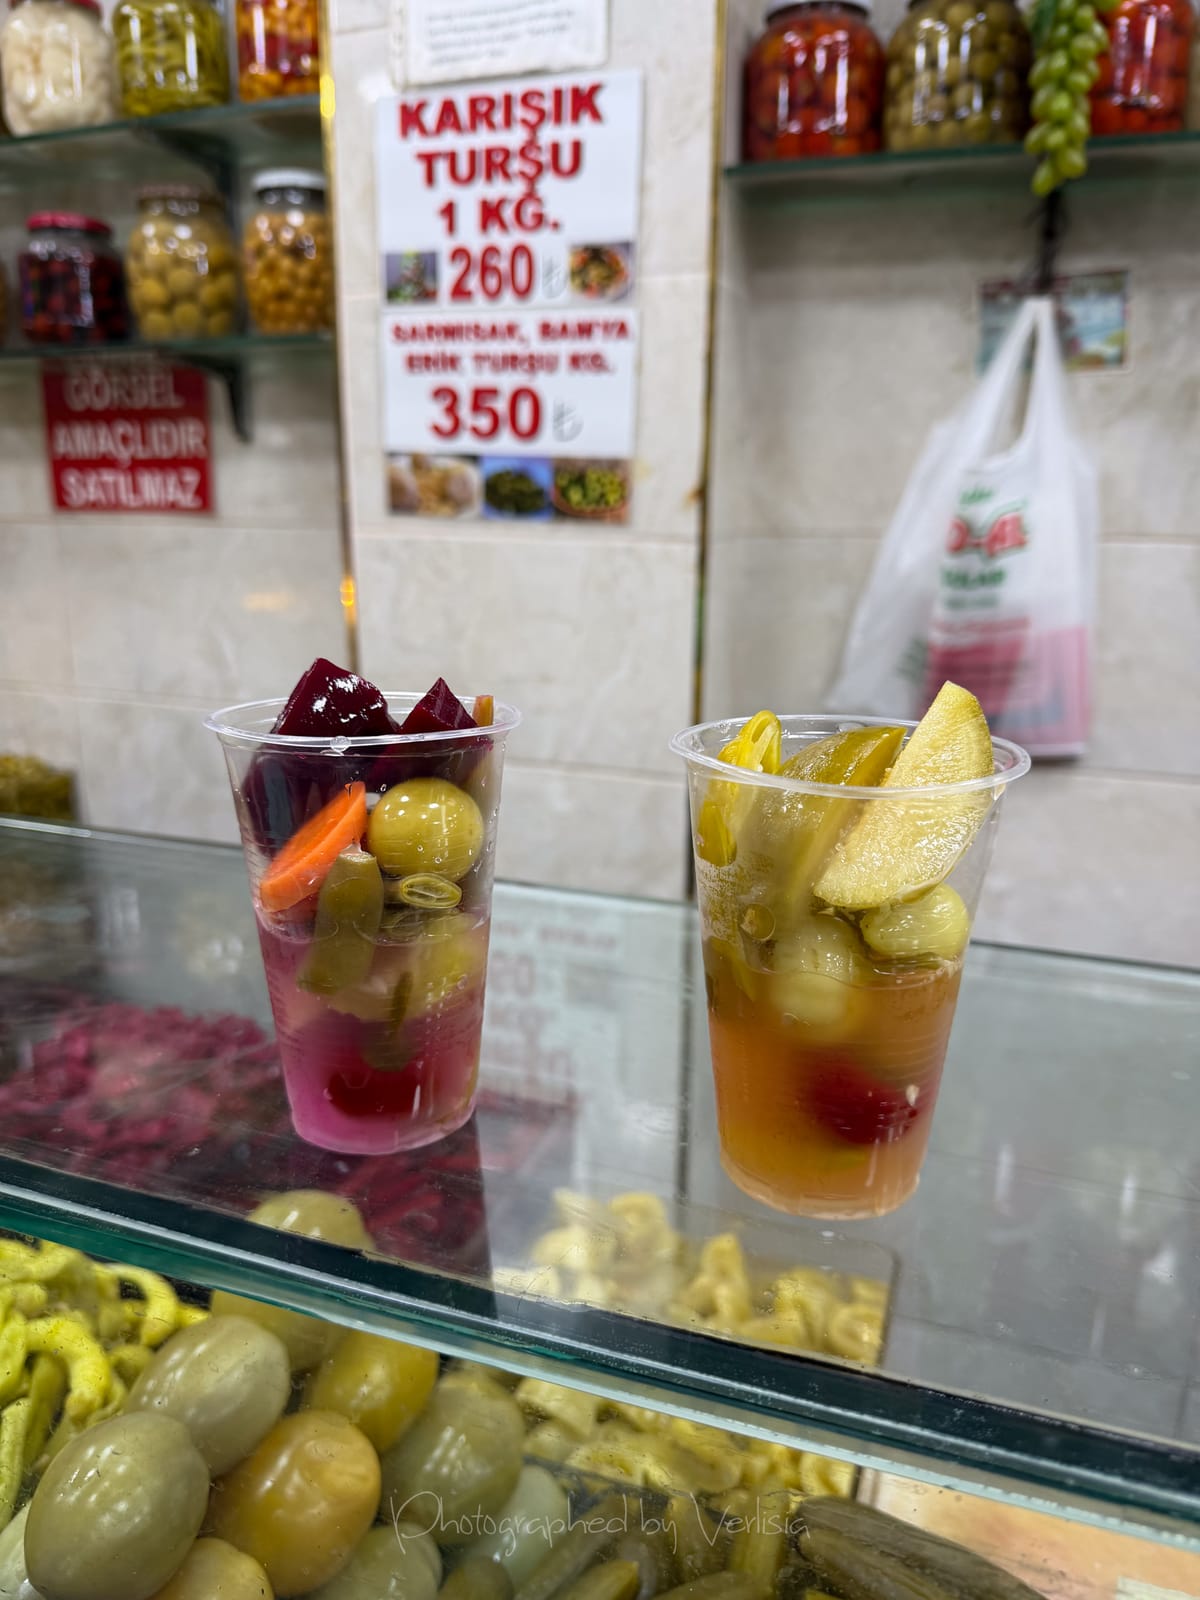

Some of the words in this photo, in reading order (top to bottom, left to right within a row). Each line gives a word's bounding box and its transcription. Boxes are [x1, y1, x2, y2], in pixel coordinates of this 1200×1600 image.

[399, 82, 604, 146] KARIŞIK
[416, 138, 583, 196] TURŞU
[436, 200, 457, 236] 1
[449, 243, 535, 302] 260
[430, 385, 542, 442] 350
[53, 418, 208, 468] AMAÇLIDIR
[60, 466, 203, 508] SATILMAZ
